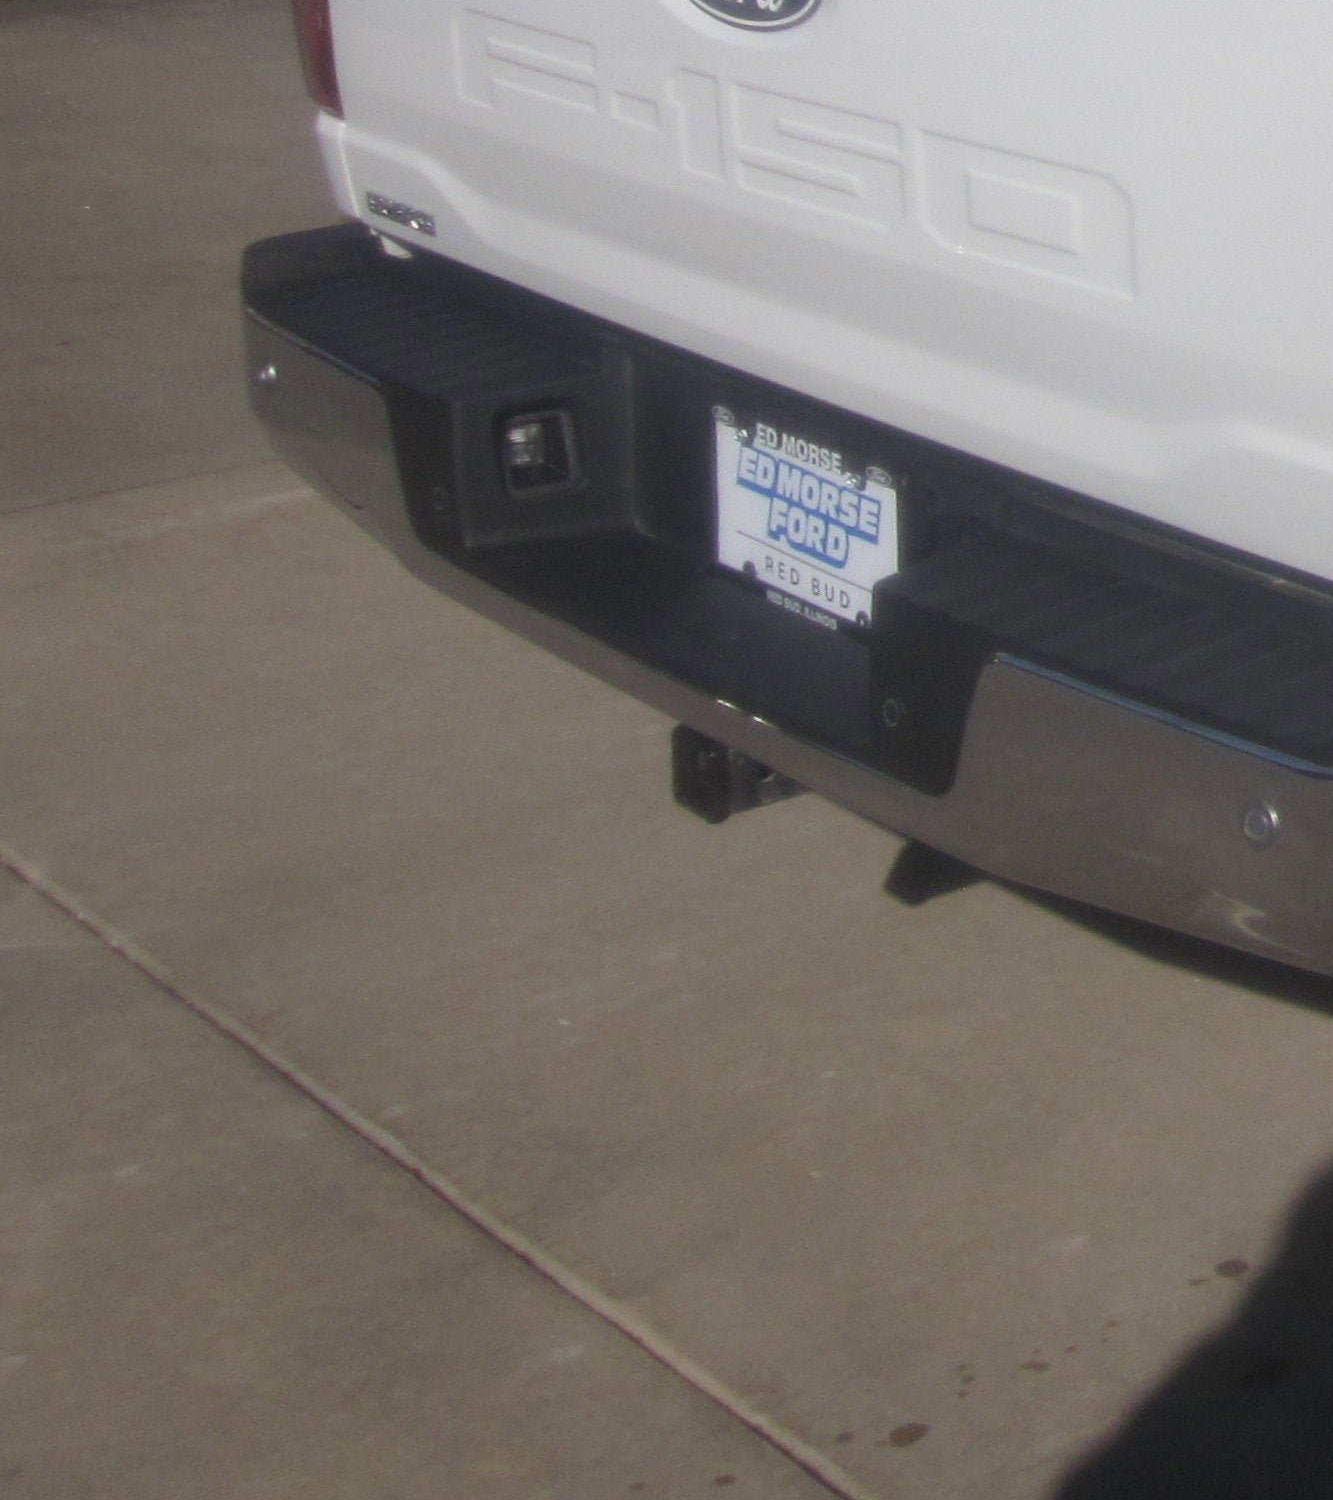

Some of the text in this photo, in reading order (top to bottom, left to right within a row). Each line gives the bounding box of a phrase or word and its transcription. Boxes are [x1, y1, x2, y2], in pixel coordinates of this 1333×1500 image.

[450, 7, 1137, 300] F-150
[754, 421, 843, 475] ED MORSE
[738, 446, 881, 539] ED MORSE
[768, 496, 849, 565] FORD
[765, 555, 850, 609] RED BUD
